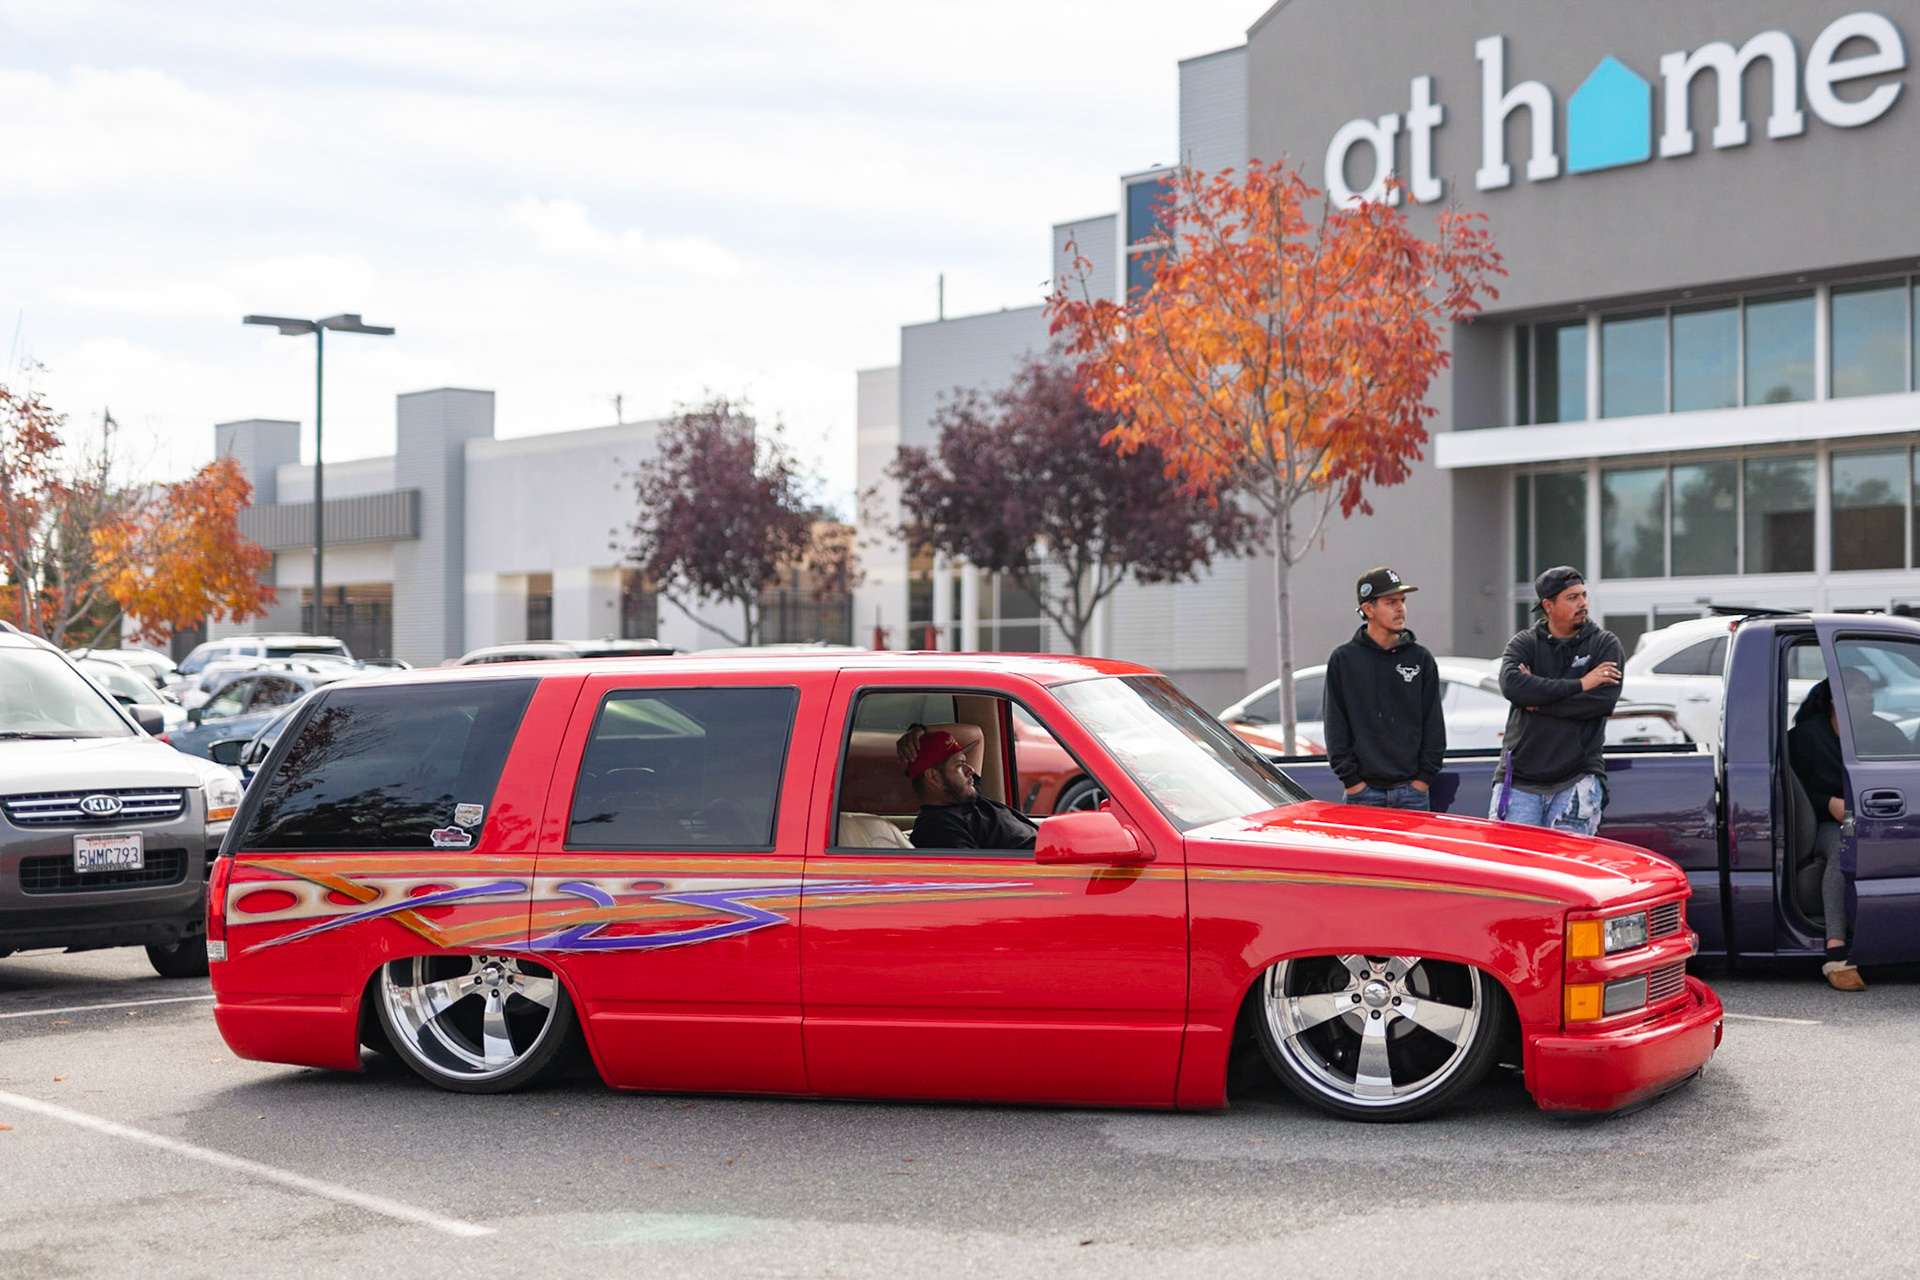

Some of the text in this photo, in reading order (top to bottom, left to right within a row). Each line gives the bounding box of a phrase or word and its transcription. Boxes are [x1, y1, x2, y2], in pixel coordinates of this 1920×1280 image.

[1324, 11, 1907, 210] at hme
[1386, 570, 1400, 583] LA
[88, 799, 117, 810] KIA
[79, 847, 138, 867] 5WMC793
